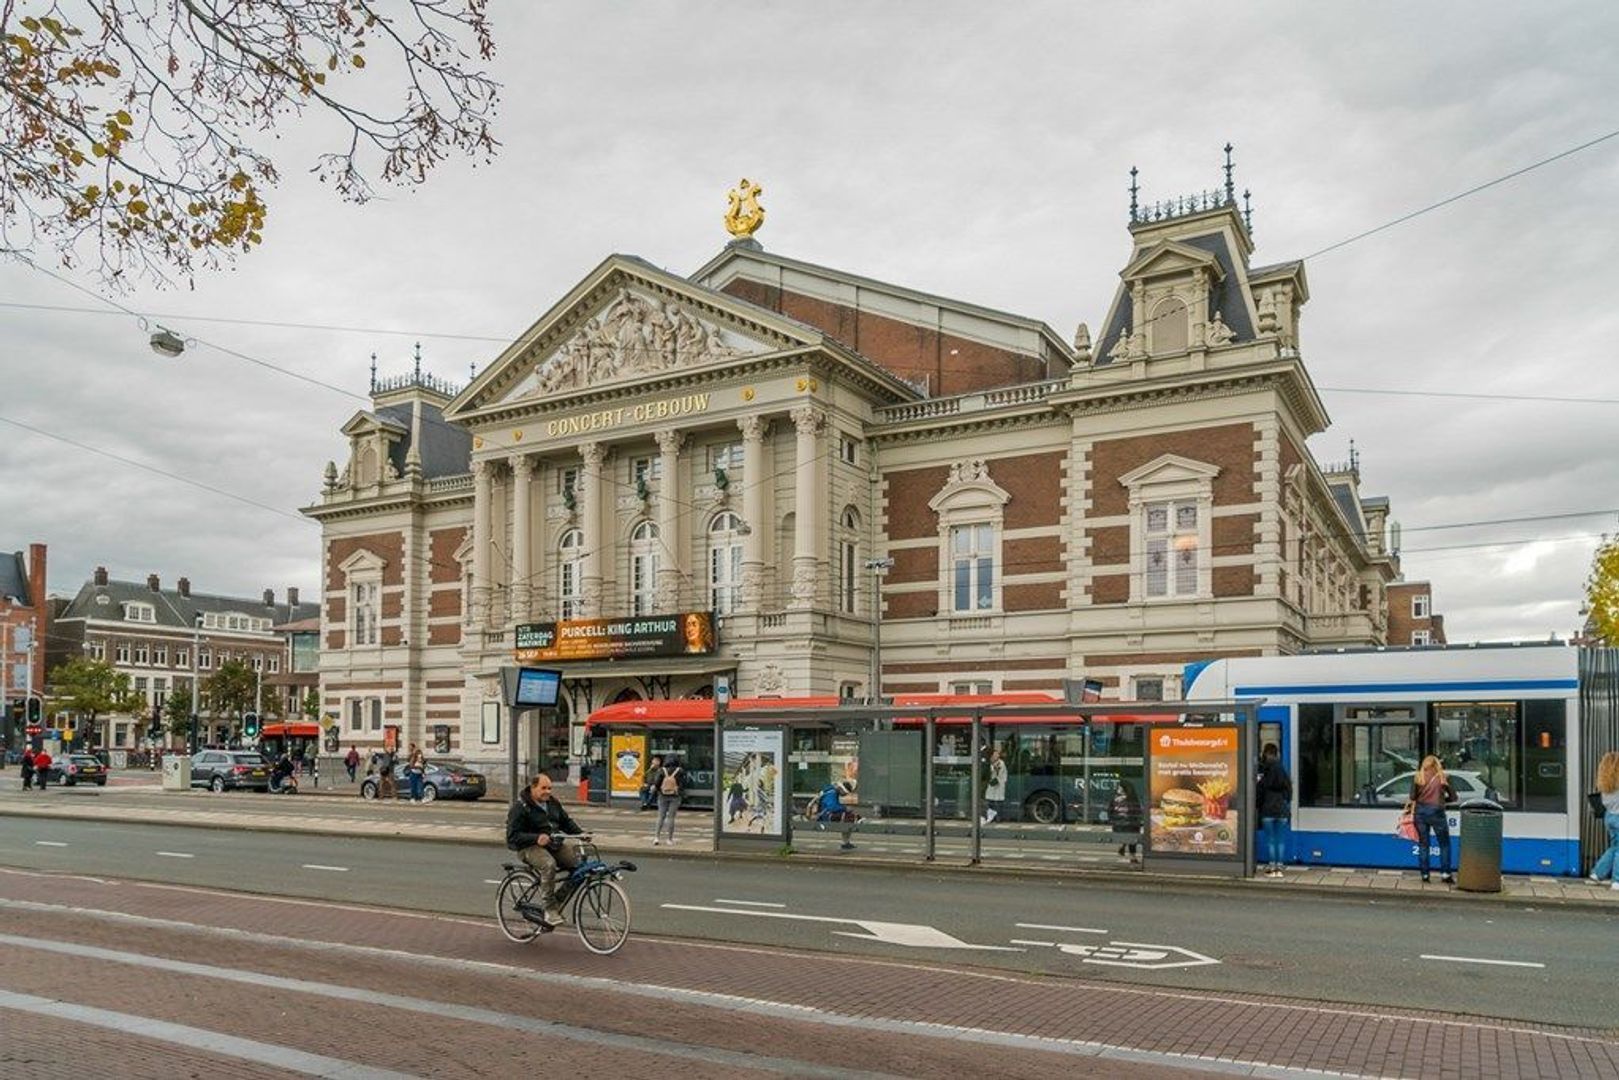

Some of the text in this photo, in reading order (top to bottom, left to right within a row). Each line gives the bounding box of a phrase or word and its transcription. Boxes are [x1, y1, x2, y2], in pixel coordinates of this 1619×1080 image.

[561, 619, 677, 638] PURCELL: KING ARTHUR
